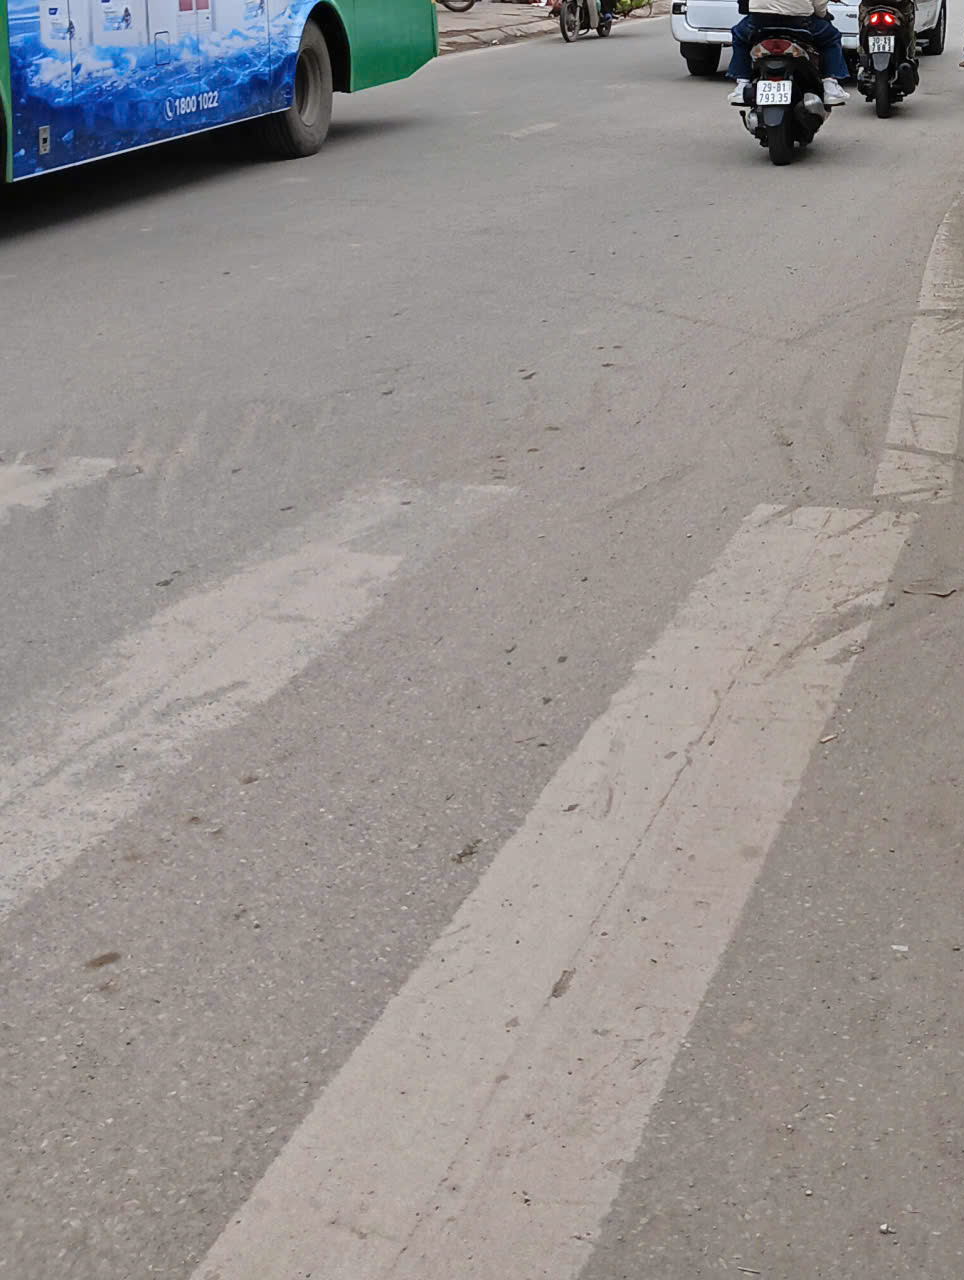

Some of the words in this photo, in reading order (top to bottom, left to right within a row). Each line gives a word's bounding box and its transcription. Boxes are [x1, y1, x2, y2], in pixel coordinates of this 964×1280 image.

[763, 82, 786, 93] 29-B1
[175, 95, 197, 116] 1800
[198, 91, 219, 111] 1022
